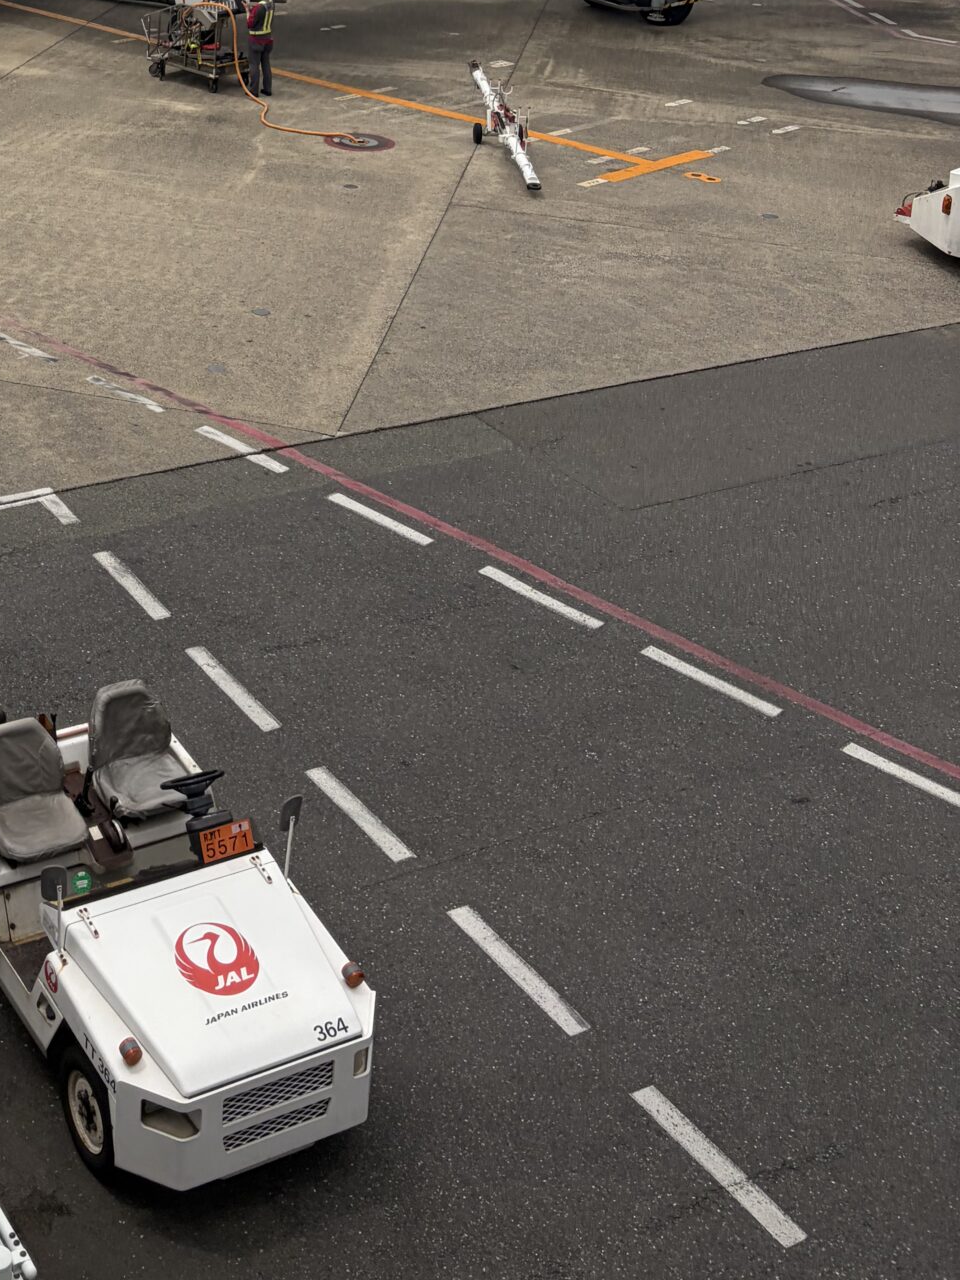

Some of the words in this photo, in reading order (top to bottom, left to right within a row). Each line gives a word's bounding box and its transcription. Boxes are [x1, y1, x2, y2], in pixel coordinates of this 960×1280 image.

[206, 832, 249, 859] 5571
[215, 966, 255, 991] JAL
[205, 1007, 239, 1026] JAPAN
[240, 991, 289, 1013] AIRLINES
[313, 1017, 349, 1042] 364
[83, 1032, 97, 1060] TT
[97, 1057, 117, 1094] 364
